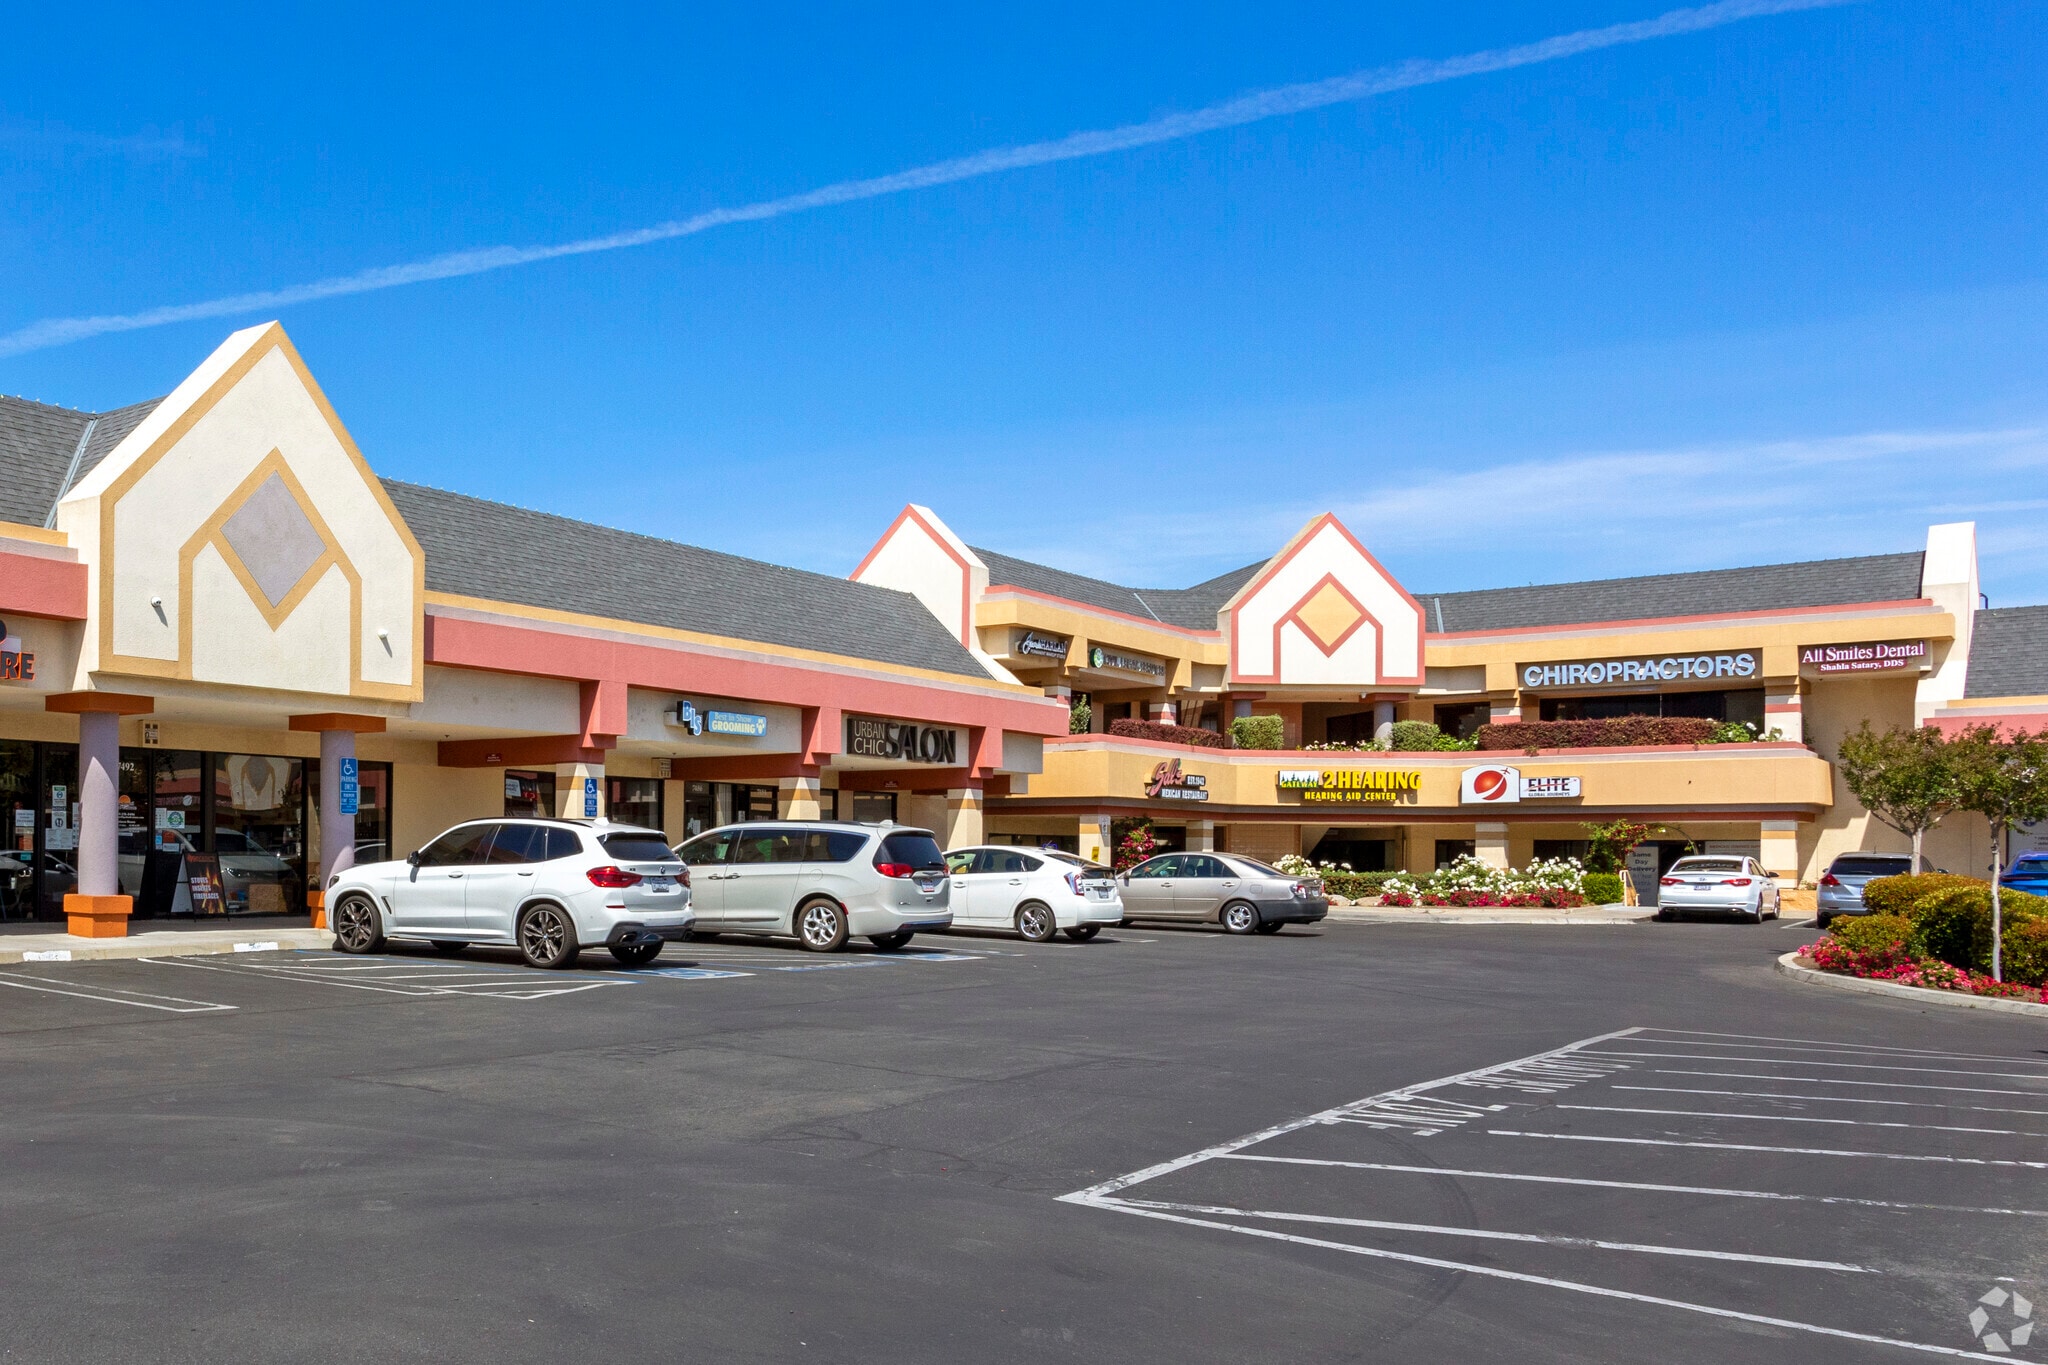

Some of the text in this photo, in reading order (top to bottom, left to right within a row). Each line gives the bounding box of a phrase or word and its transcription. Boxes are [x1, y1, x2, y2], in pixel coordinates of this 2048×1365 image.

[1801, 640, 1924, 663] All Smiles Dental
[1524, 653, 1755, 687] CHIROPRACTORS
[1820, 659, 1904, 672] Shahla Satary, DDS
[682, 700, 702, 736] BIS
[714, 712, 728, 721] Best
[712, 720, 756, 734] GROOMING
[854, 720, 956, 764] URBAN SALON
[854, 737, 885, 756] CHIC
[1322, 770, 1334, 789] 2
[1337, 770, 1421, 790] HEARING
[1528, 777, 1571, 792] ELITE
[1161, 788, 1208, 801] MEXICAN RESTAURANT
[1304, 791, 1397, 801] HEARING AID CENTER
